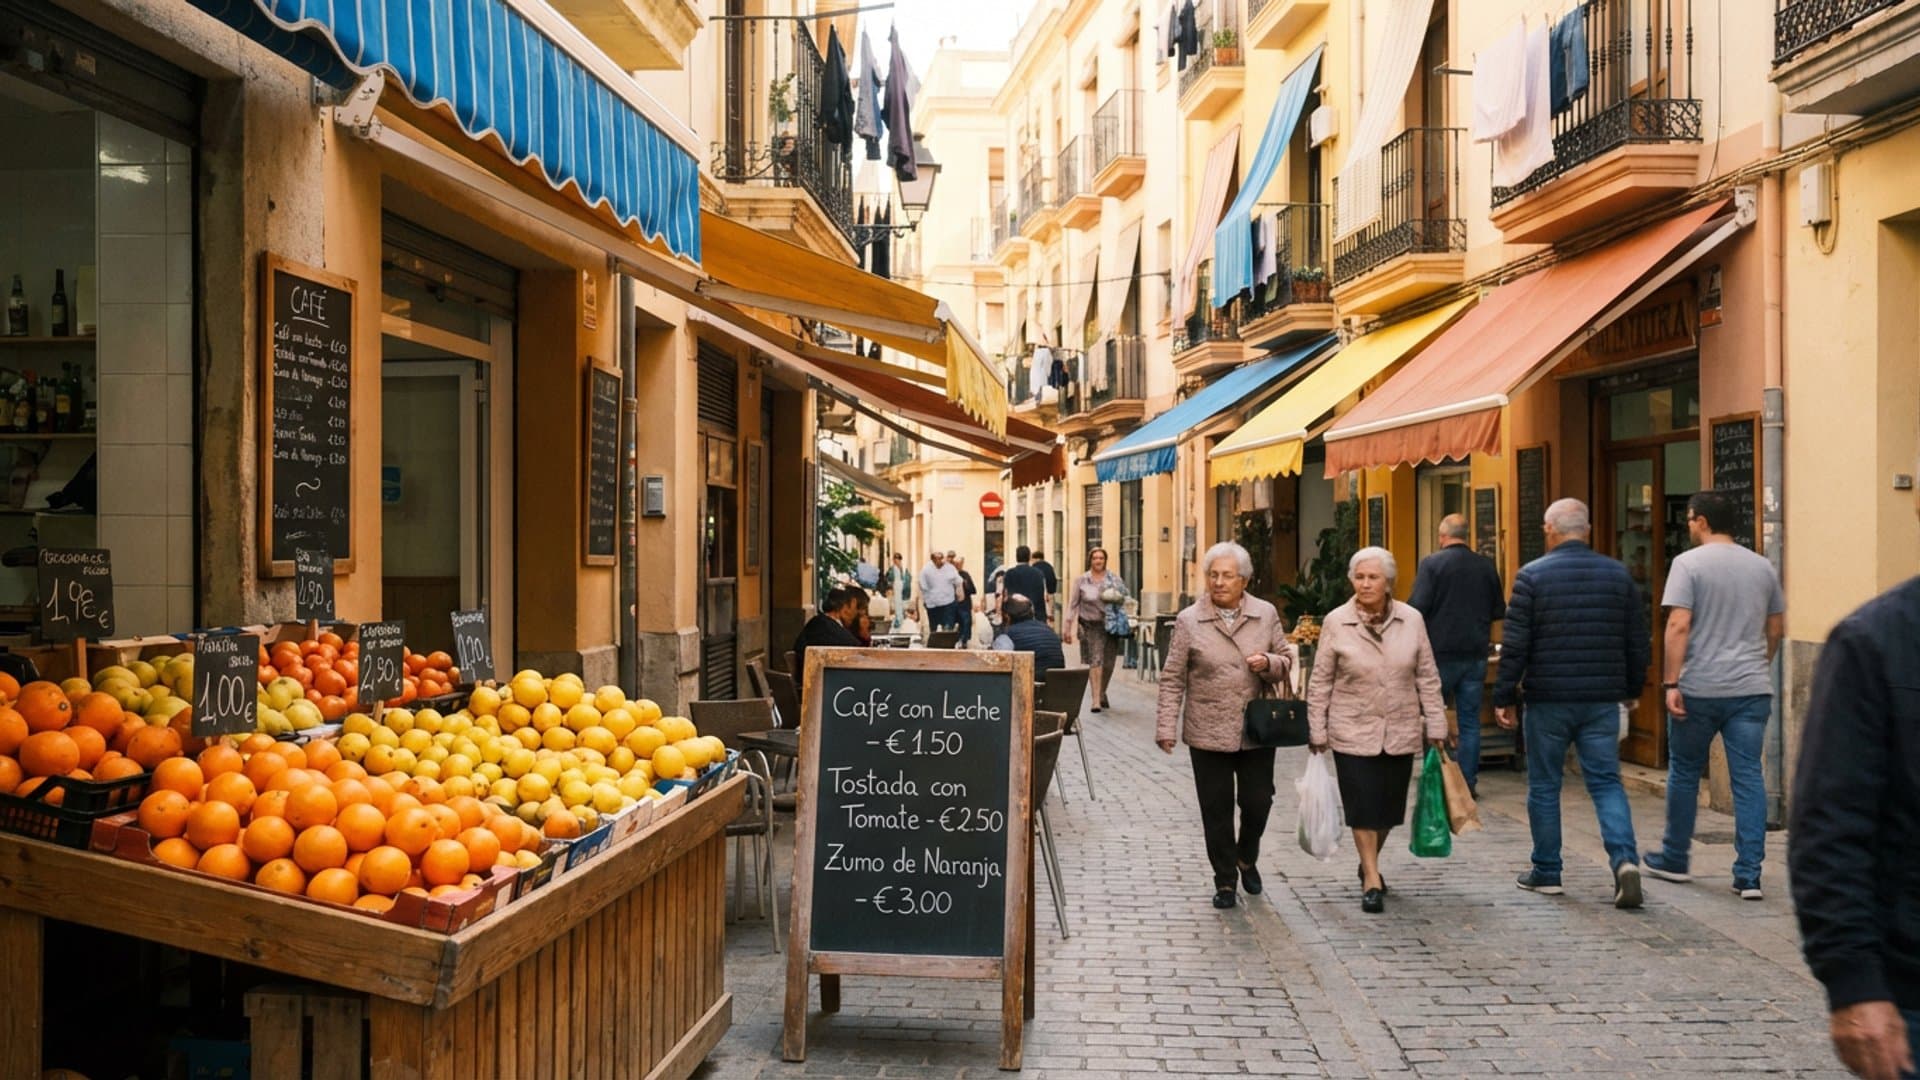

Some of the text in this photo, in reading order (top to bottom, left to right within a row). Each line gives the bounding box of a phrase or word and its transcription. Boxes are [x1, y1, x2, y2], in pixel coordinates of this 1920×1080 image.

[290, 285, 327, 321] CAFÉ
[832, 686, 1001, 726] Café con Leche
[826, 766, 967, 798] Tostada con
[839, 803, 921, 830] Tomate
[823, 842, 1002, 889] Zumo de Naranja
